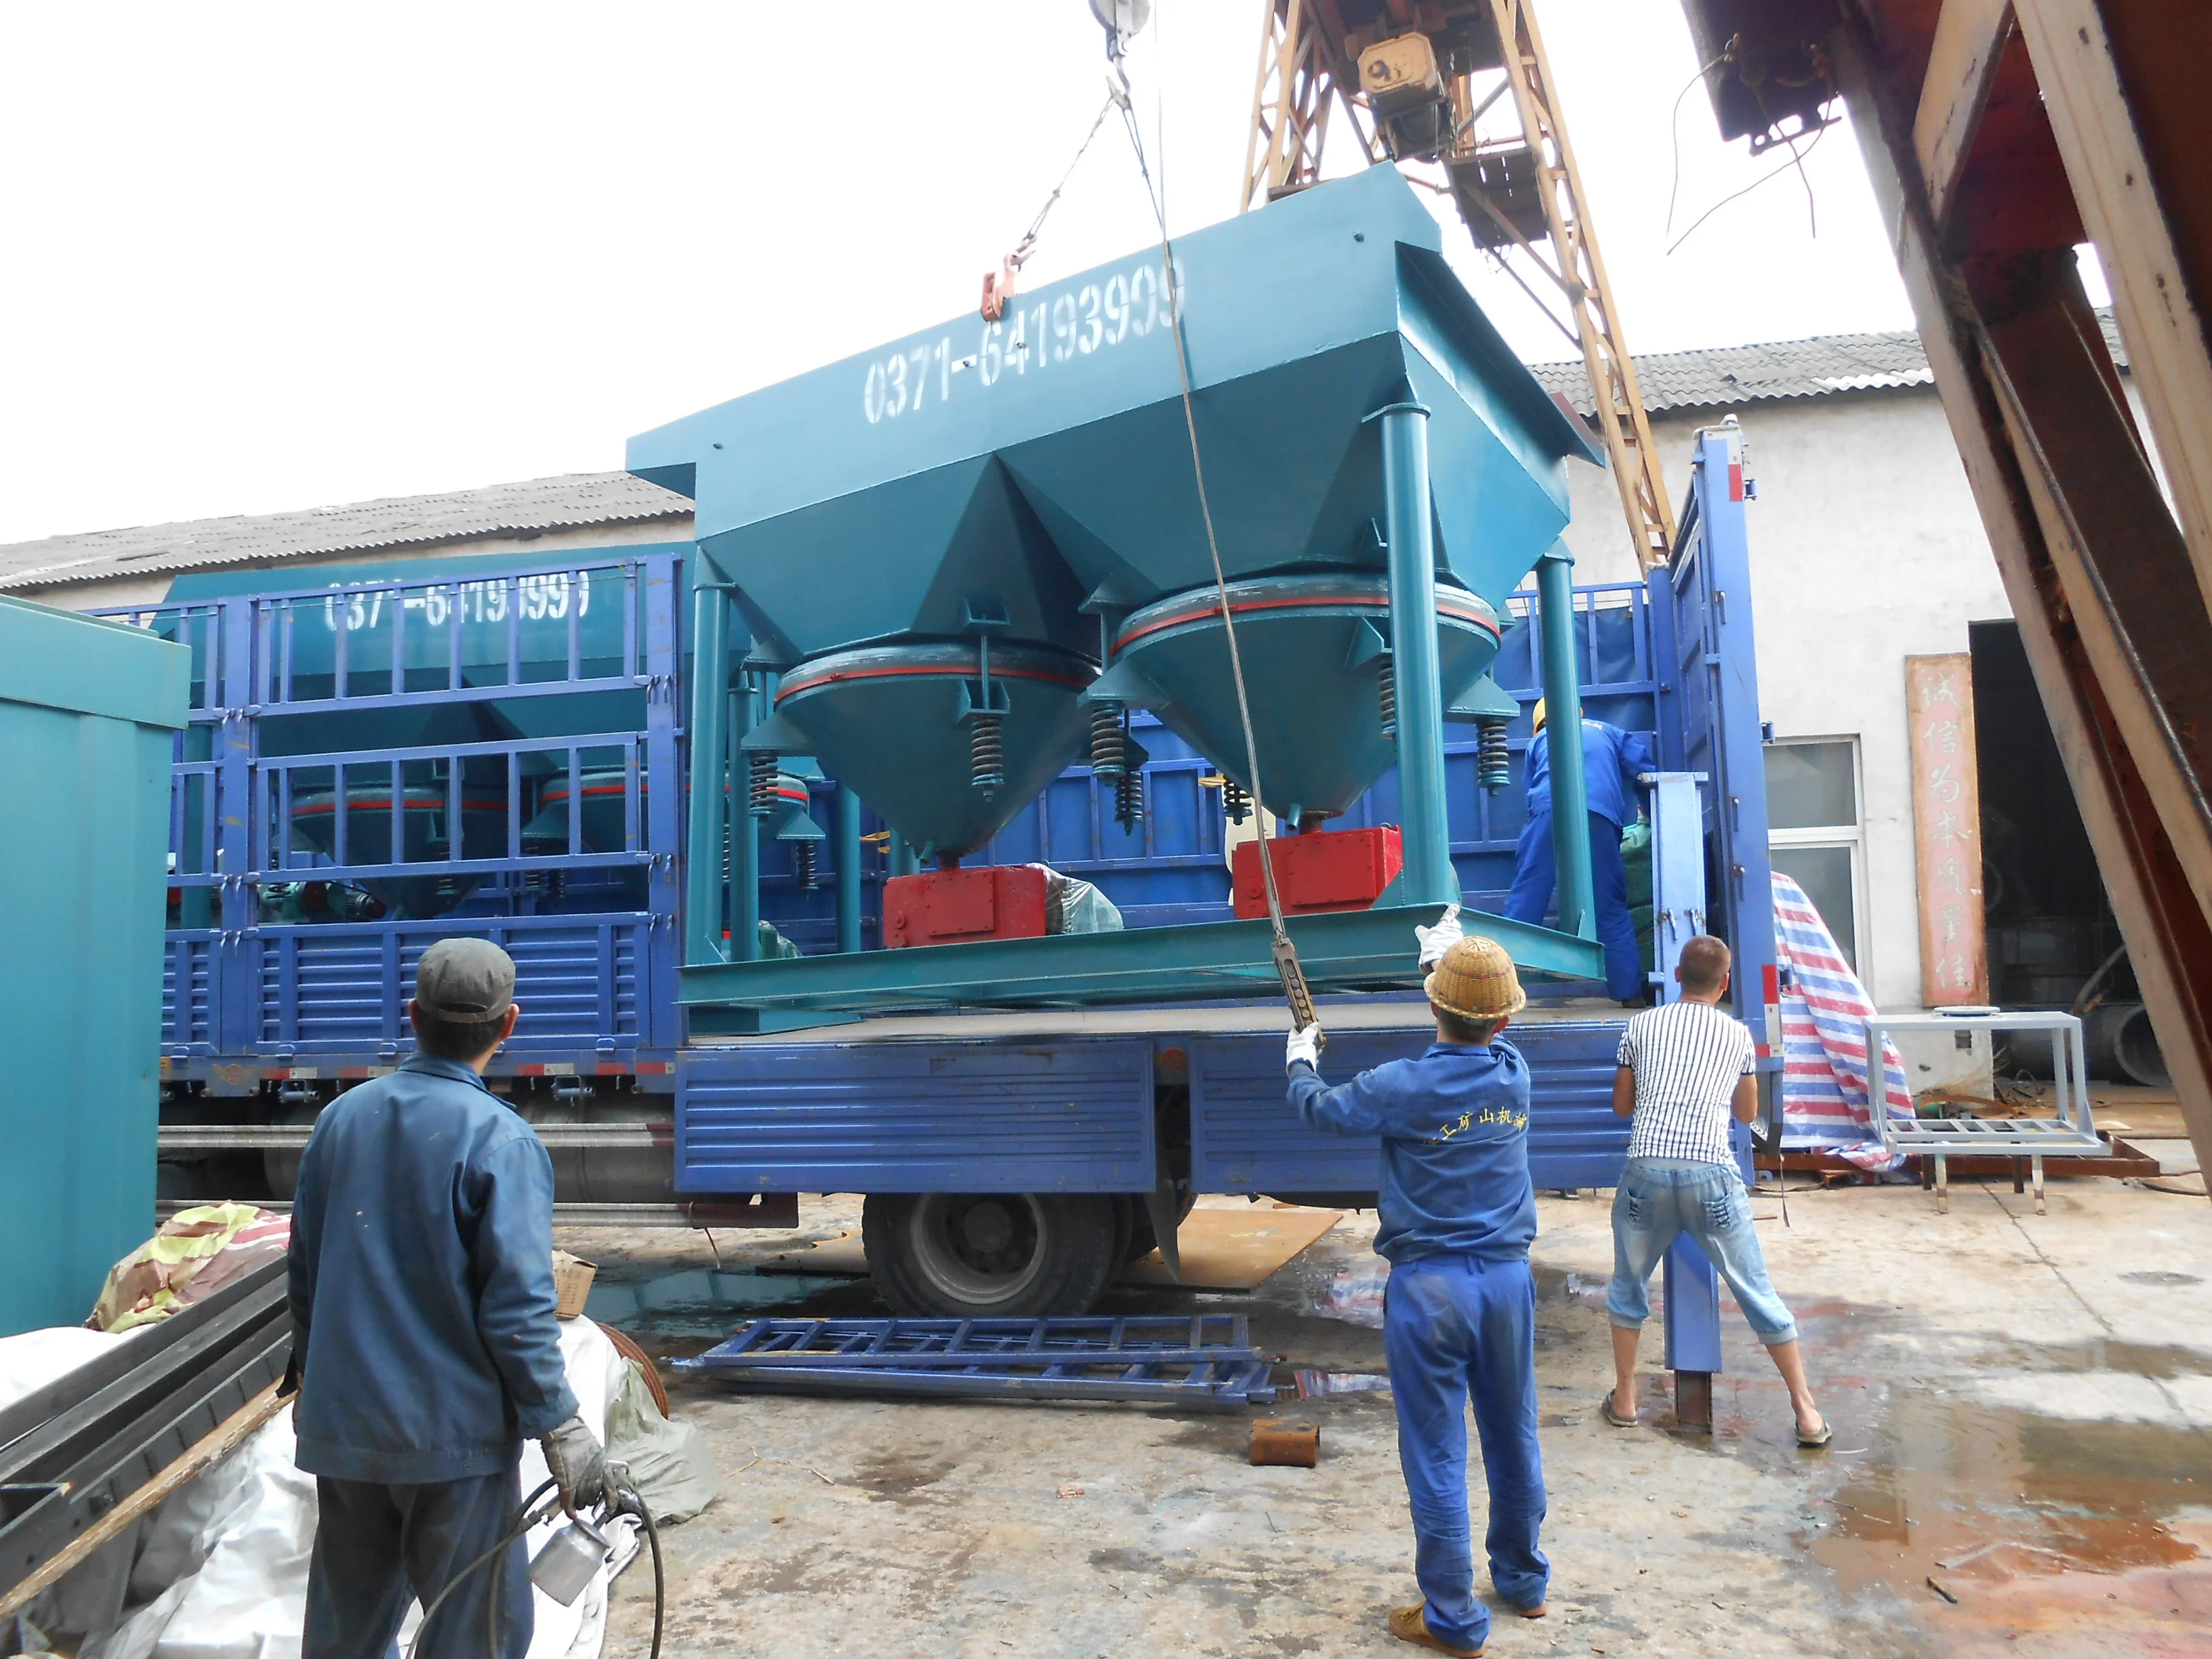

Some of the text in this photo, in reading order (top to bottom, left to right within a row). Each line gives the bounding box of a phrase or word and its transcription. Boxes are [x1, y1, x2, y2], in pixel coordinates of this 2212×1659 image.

[864, 258, 1185, 424] 0371-64193999
[1428, 1105, 1527, 1144] 工矿山机械
